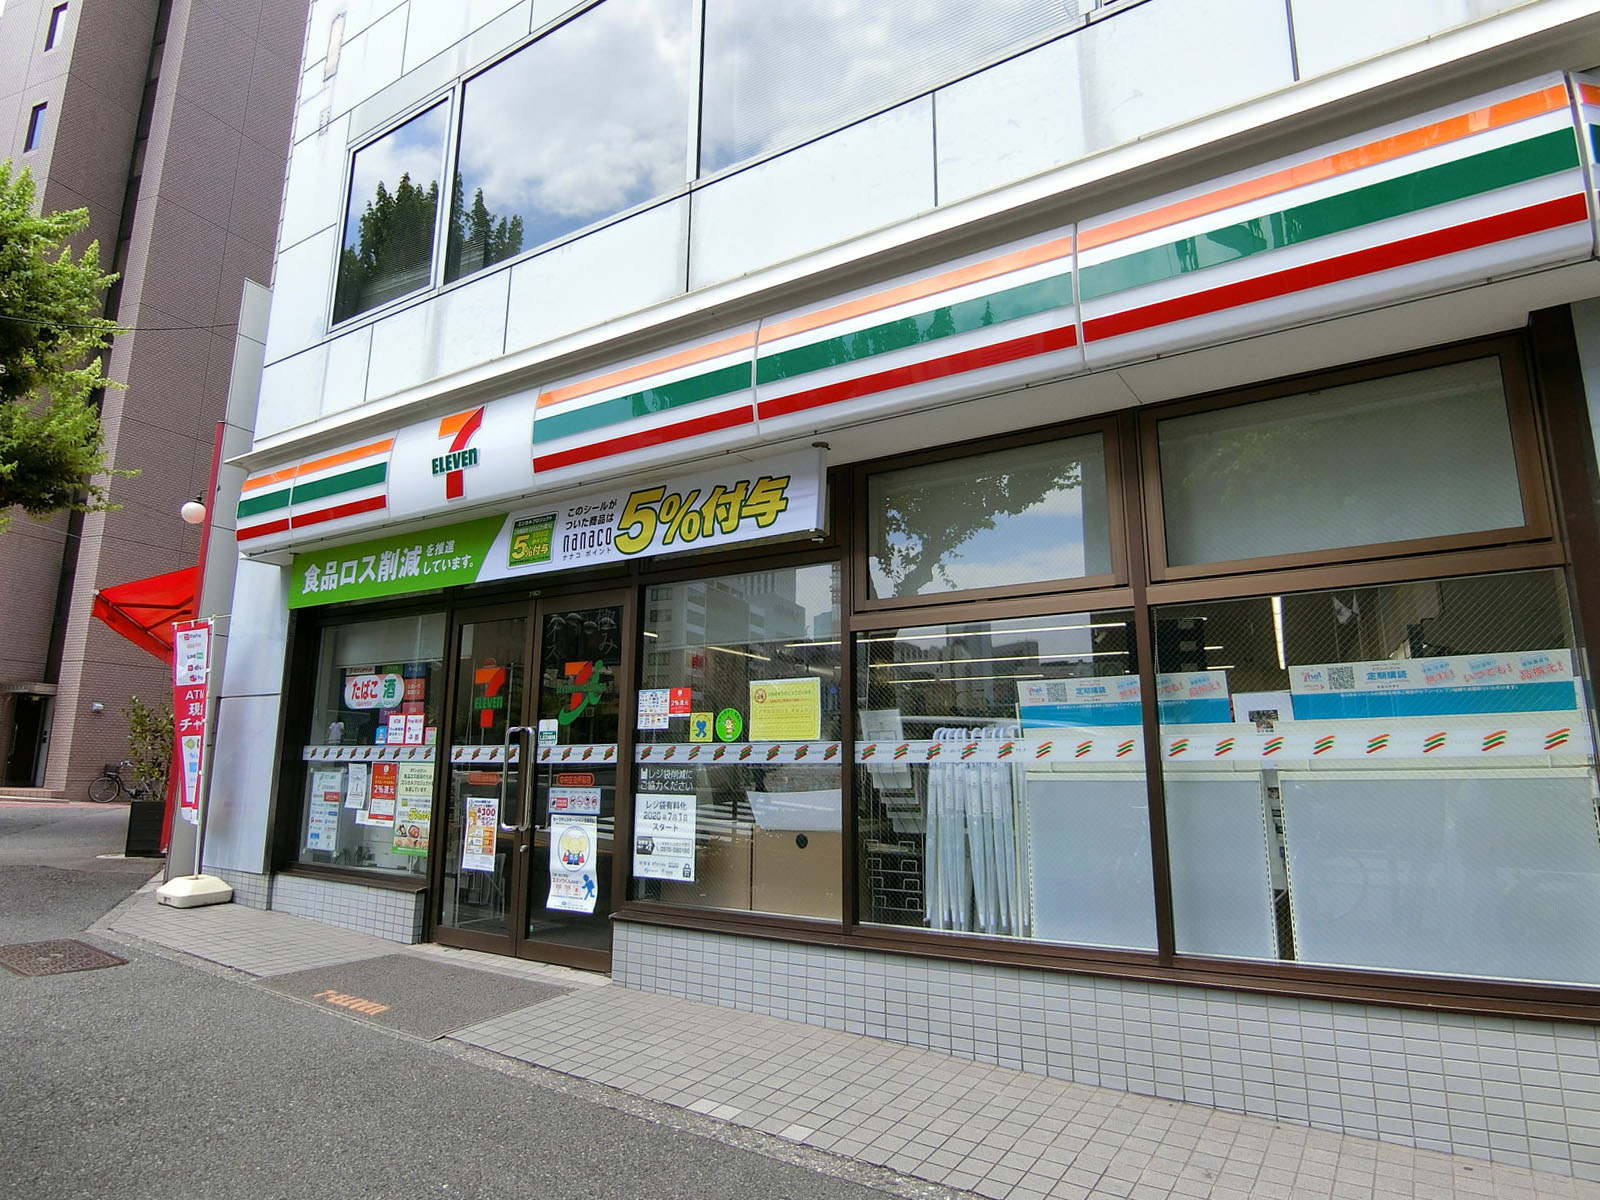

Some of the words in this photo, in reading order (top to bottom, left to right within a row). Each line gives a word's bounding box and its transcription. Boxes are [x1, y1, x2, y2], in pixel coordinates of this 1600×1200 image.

[567, 499, 617, 517] このシールが
[614, 475, 791, 555] 5%付与
[565, 513, 614, 530] ついた商品は
[426, 540, 456, 557] を推進
[562, 527, 612, 553] nanaco
[302, 545, 423, 595] 食品ロス削減
[423, 554, 474, 576] しています。
[352, 680, 379, 701] たばこ
[383, 678, 397, 699] 酒
